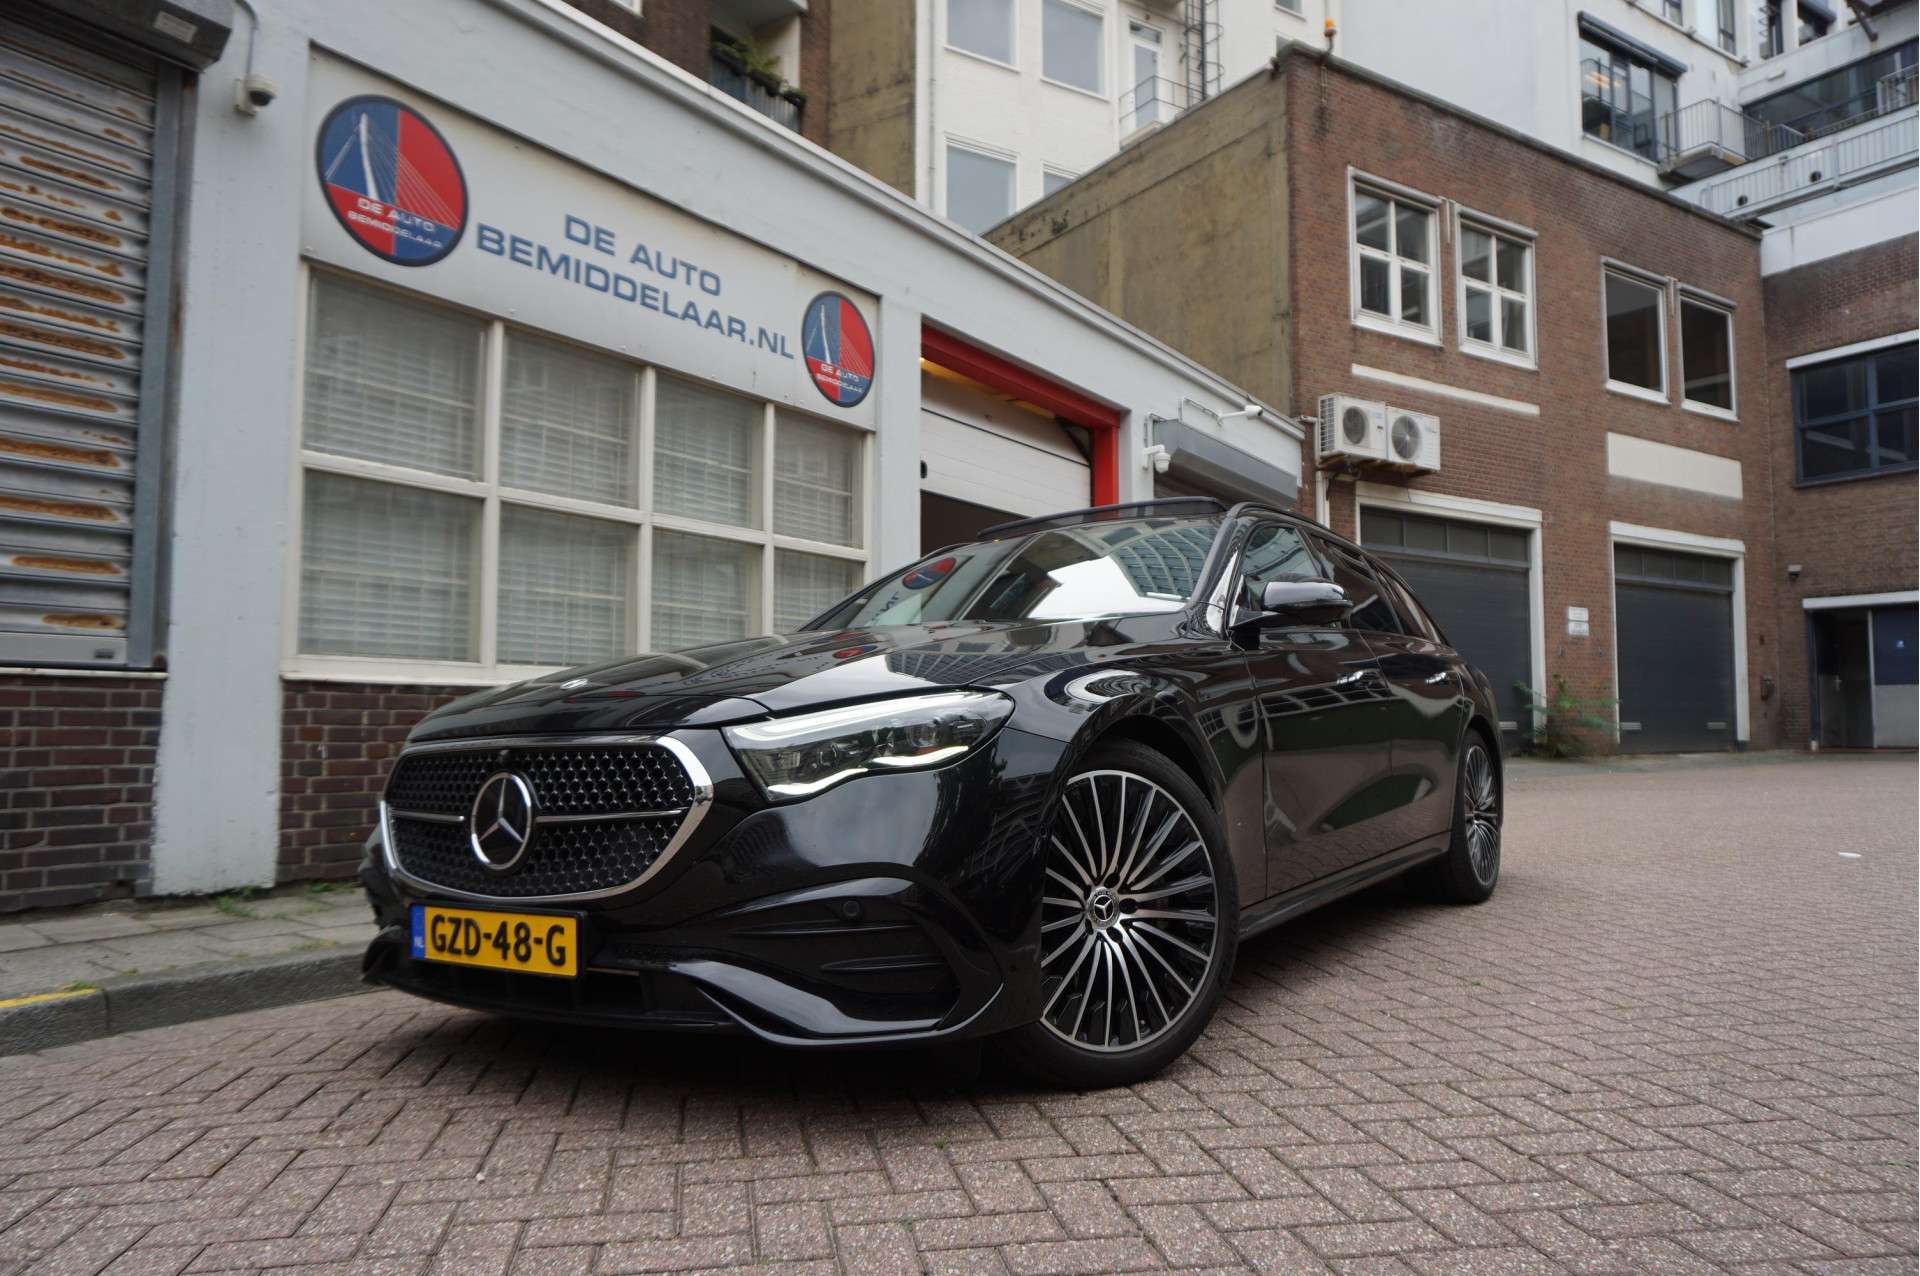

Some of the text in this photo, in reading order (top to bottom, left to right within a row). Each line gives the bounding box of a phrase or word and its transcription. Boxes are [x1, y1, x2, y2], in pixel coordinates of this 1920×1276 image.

[347, 210, 443, 248] BEMIDDELAAR
[357, 197, 434, 232] DE AUTO
[564, 213, 722, 297] DE AUTO
[476, 222, 795, 360] BEMIDDELAAR.NL
[820, 362, 860, 382] DE AUTO
[430, 913, 567, 967] GZD-48-G
